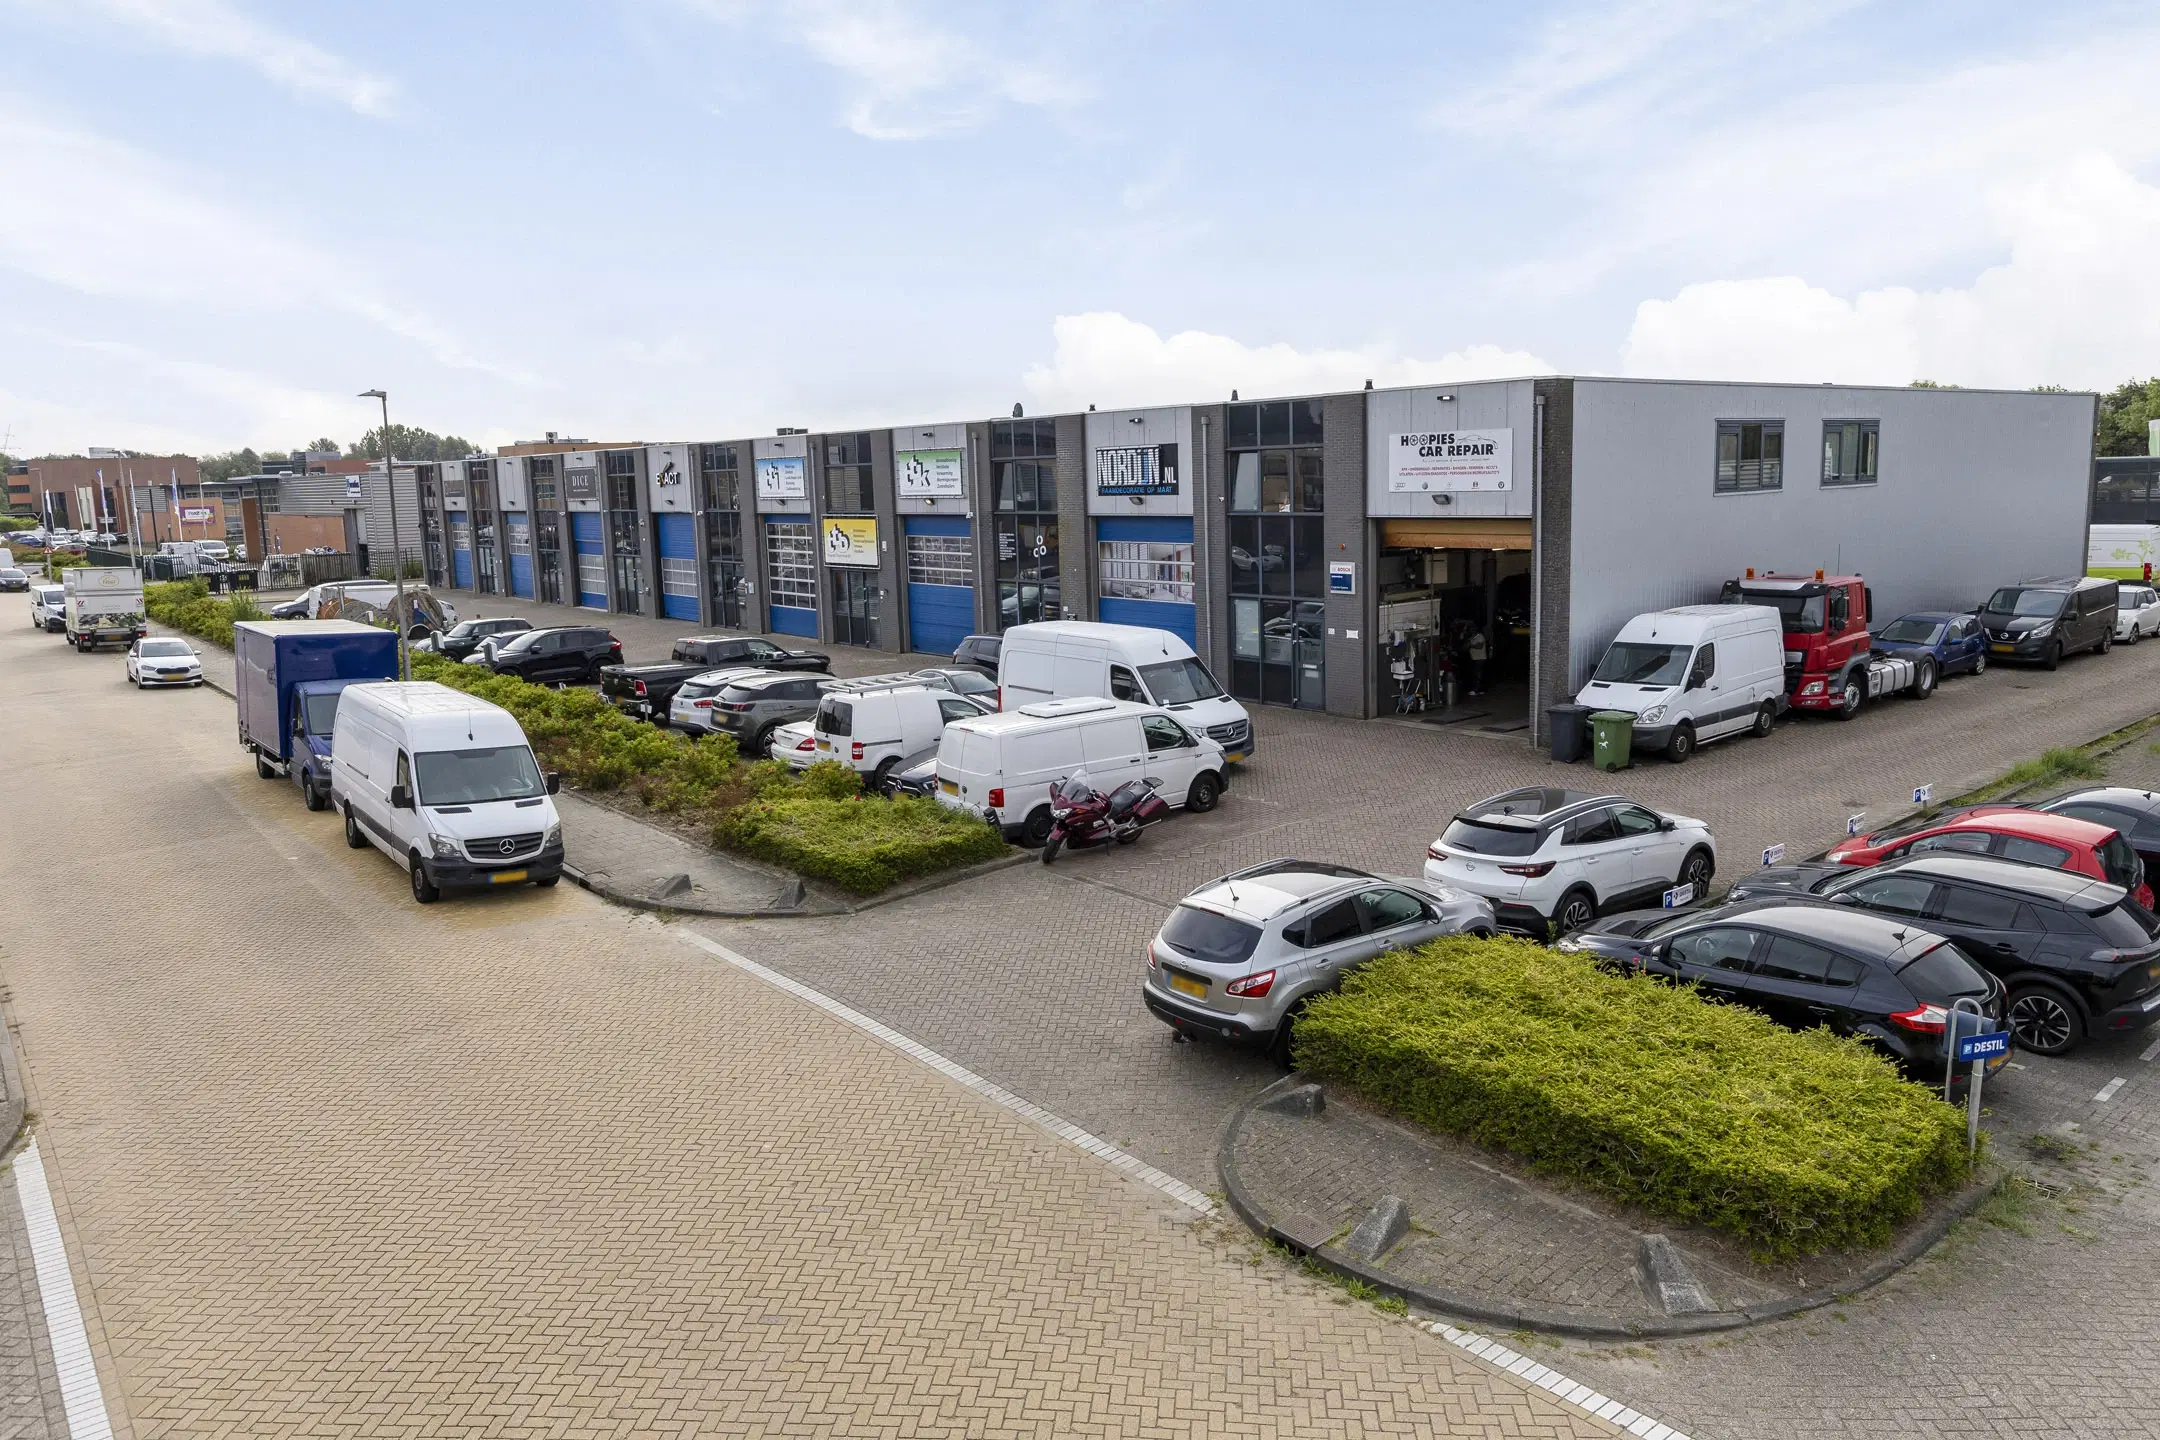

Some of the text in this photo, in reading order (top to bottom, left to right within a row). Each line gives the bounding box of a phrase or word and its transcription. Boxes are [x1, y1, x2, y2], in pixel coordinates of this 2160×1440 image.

[1400, 433, 1455, 446] HOOPIES
[1419, 443, 1494, 457] CAR REPAIR
[572, 475, 588, 486] DICE
[1974, 1039, 2005, 1053] DESTIL
